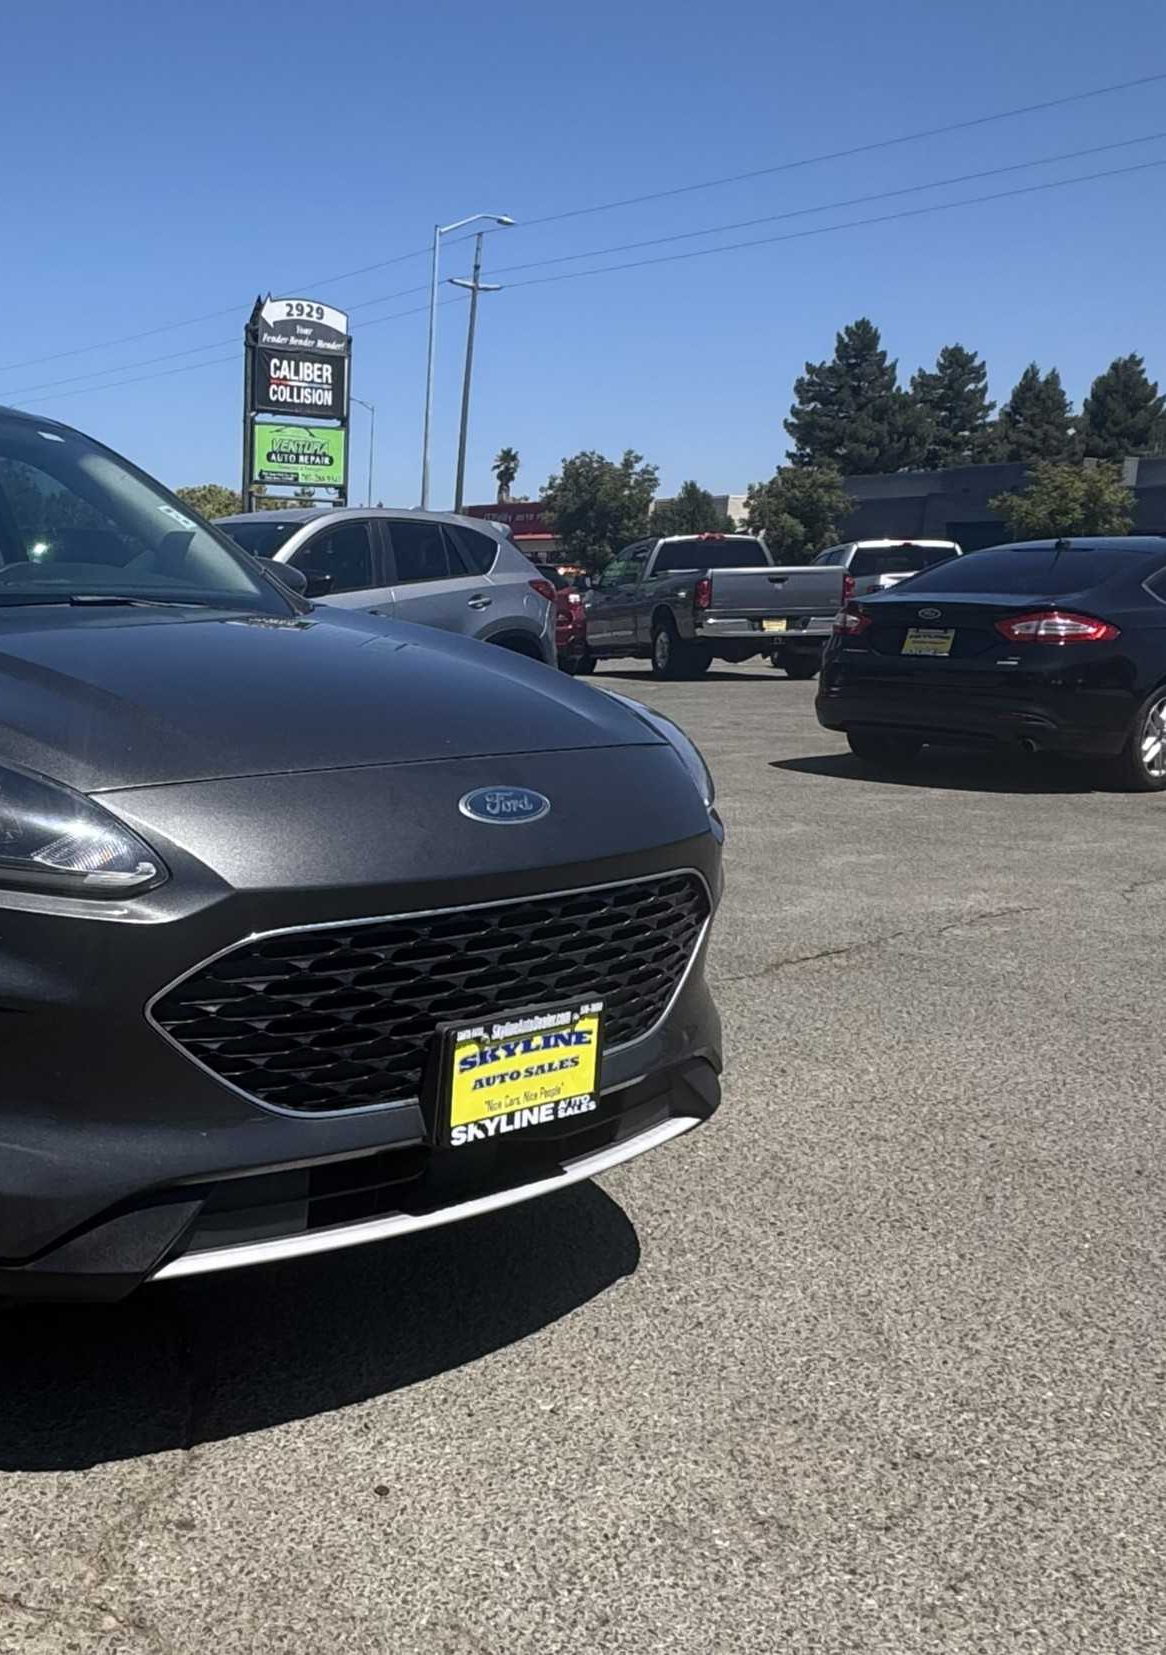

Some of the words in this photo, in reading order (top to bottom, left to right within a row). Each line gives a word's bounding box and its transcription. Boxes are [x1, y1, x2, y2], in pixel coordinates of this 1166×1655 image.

[285, 303, 324, 320] 2929
[262, 333, 289, 344] Fender
[288, 335, 315, 347] Bender
[269, 358, 333, 384] CALIBER
[269, 384, 333, 406] COLLISION
[271, 438, 330, 455] VENTURA
[270, 453, 296, 463] AUTO
[298, 454, 331, 466] REPAIR
[484, 791, 534, 815] Ford
[458, 1030, 593, 1074] SKYLINE
[472, 1071, 522, 1090] AUTO
[523, 1056, 580, 1079] SALES
[450, 1102, 555, 1147] SKYLINE
[559, 1094, 591, 1110] AUTO
[557, 1100, 597, 1119] SALES
